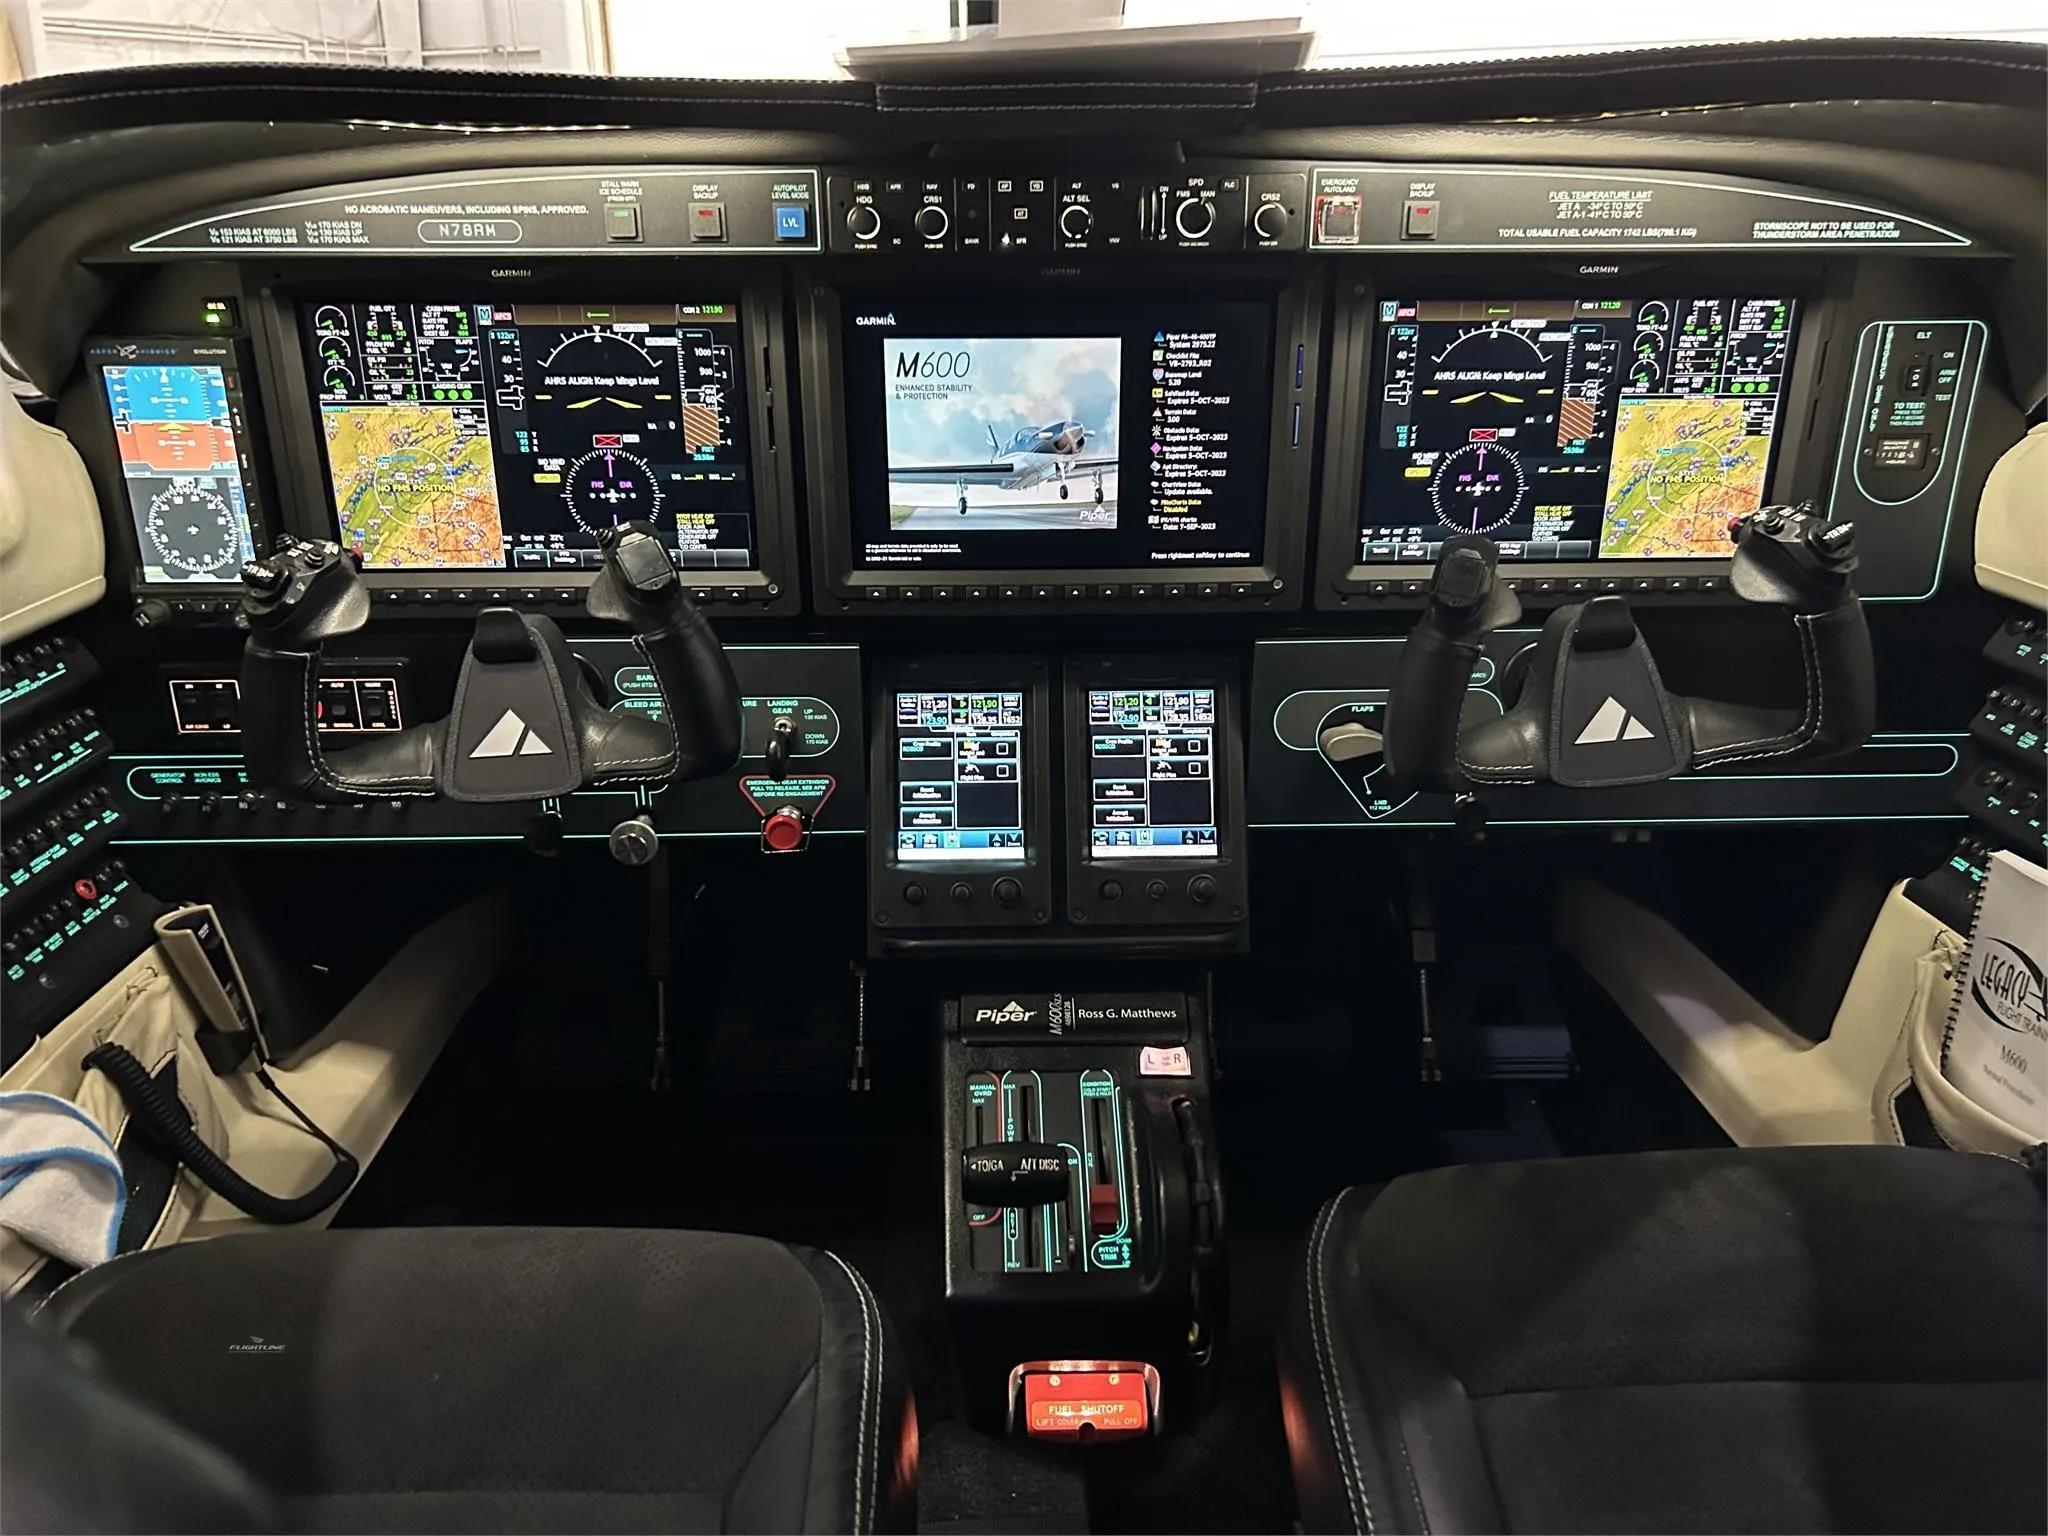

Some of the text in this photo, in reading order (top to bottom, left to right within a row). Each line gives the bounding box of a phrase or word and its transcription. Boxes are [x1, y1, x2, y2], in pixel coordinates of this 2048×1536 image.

[1188, 178, 1204, 186] SPD
[1550, 191, 1653, 200] FUEL TEMPERATURE LIMIT
[344, 205, 589, 215] NO ACROBATIC MANEUVERS, INCLUDING SPINS, APPROVED.
[783, 217, 799, 227] LVL
[1754, 222, 1895, 230] STORMSCOPE NOT TO BE USED FOR
[439, 224, 496, 236] N78RM
[1499, 229, 1641, 237] TOTAL USABLE FUEL CAPACITY 1742
[856, 316, 896, 326] GARMIN
[502, 355, 512, 364] 40
[1397, 350, 1407, 359] 40
[896, 352, 971, 378] M600
[504, 374, 514, 383] 30
[1395, 370, 1405, 378] 30
[1434, 371, 1546, 381] AHRS Keep Wings Level
[544, 376, 660, 386] AHRS Keep Wings Level
[1650, 475, 1664, 484] NO
[1685, 475, 1724, 484] POSITION
[1079, 510, 1110, 521] Piper
[922, 700, 947, 709] 121.20
[972, 700, 997, 709] 121.90
[1114, 698, 1138, 706] 121.20
[1164, 697, 1189, 706] 121.90
[1981, 952, 2030, 1008] LEGACY
[976, 1009, 1035, 1024] Piper
[1078, 1009, 1177, 1019] Ross G. Matthews
[1997, 1001, 2022, 1024] FLIGHT
[1147, 1054, 1154, 1064] L
[1173, 1054, 1181, 1064] R
[2000, 1044, 2027, 1074] M600
[977, 1159, 1003, 1171] TO/GA
[1020, 1158, 1059, 1170] A/T DISC
[1048, 1405, 1124, 1414] FUEL SHUTOFF
